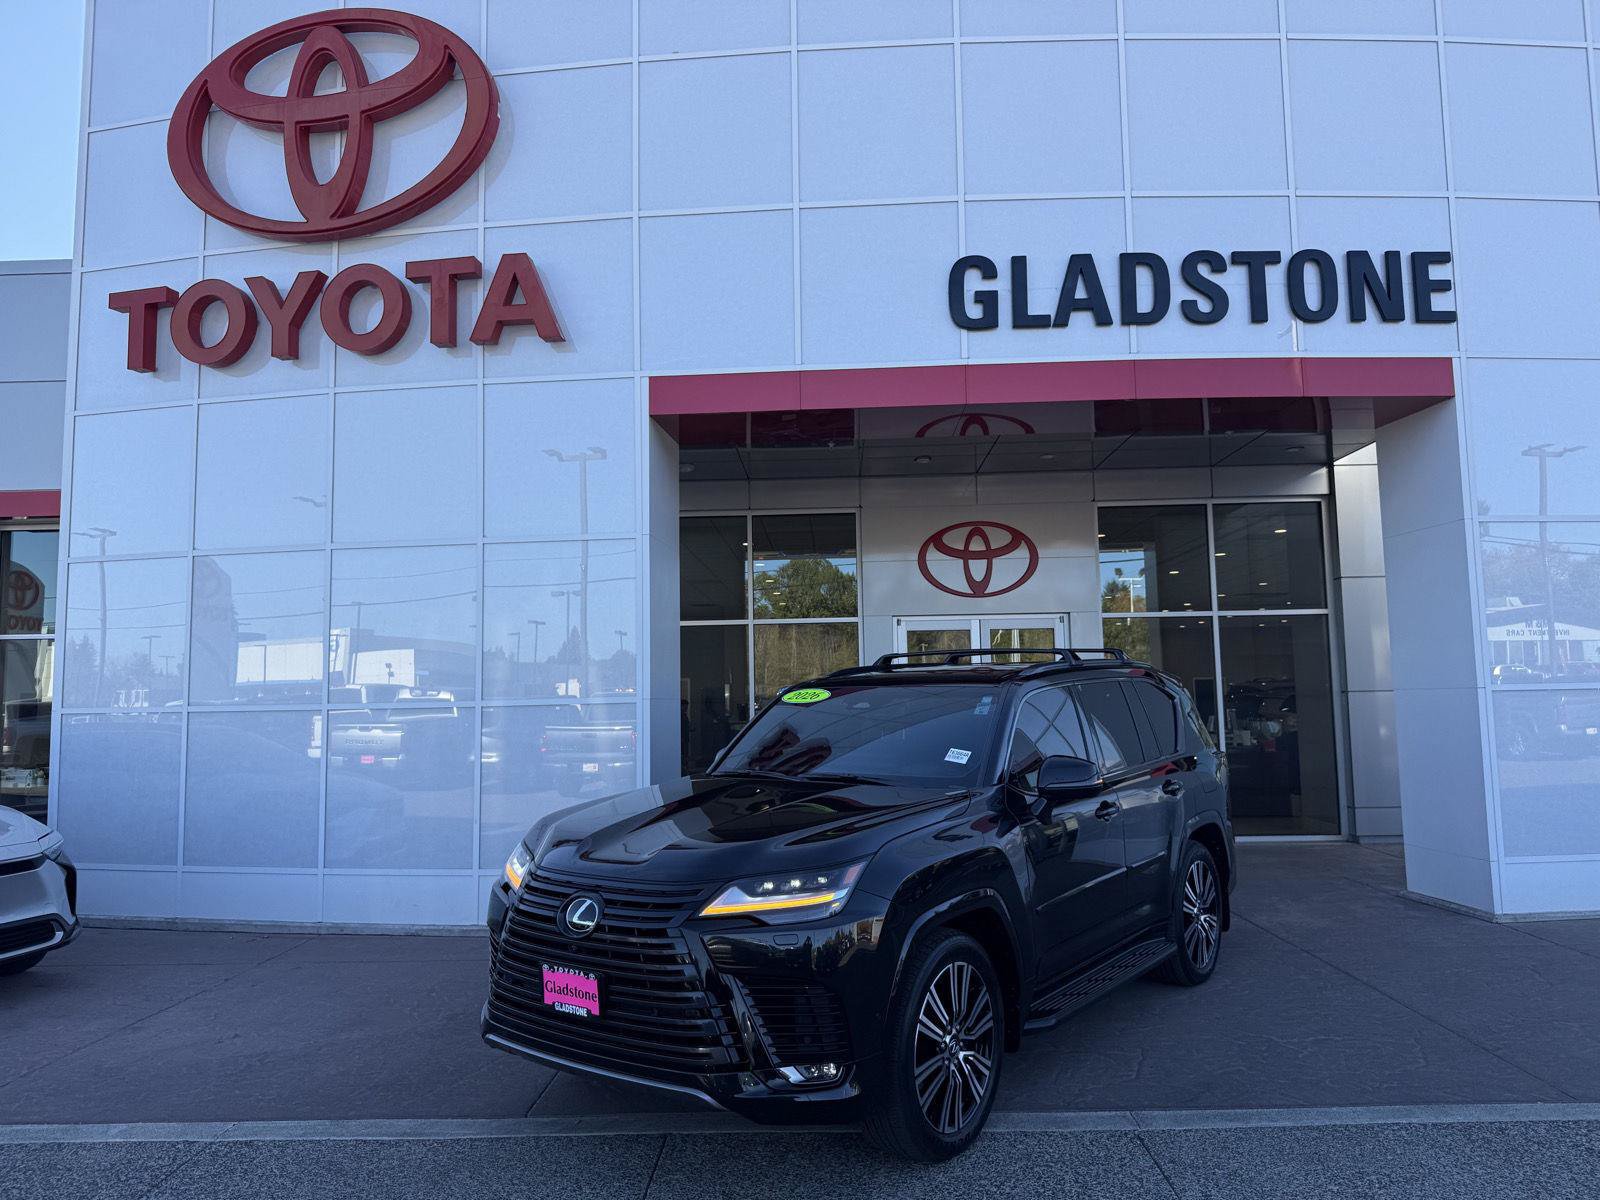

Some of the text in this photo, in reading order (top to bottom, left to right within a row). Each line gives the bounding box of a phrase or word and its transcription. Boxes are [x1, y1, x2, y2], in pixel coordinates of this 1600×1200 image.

[948, 248, 1457, 331] GLADSTONE
[108, 252, 566, 373] TOYOTA
[554, 966, 584, 977] TOYOTA
[545, 980, 598, 1002] Gladstone
[555, 1002, 587, 1017] GLADSTONE
